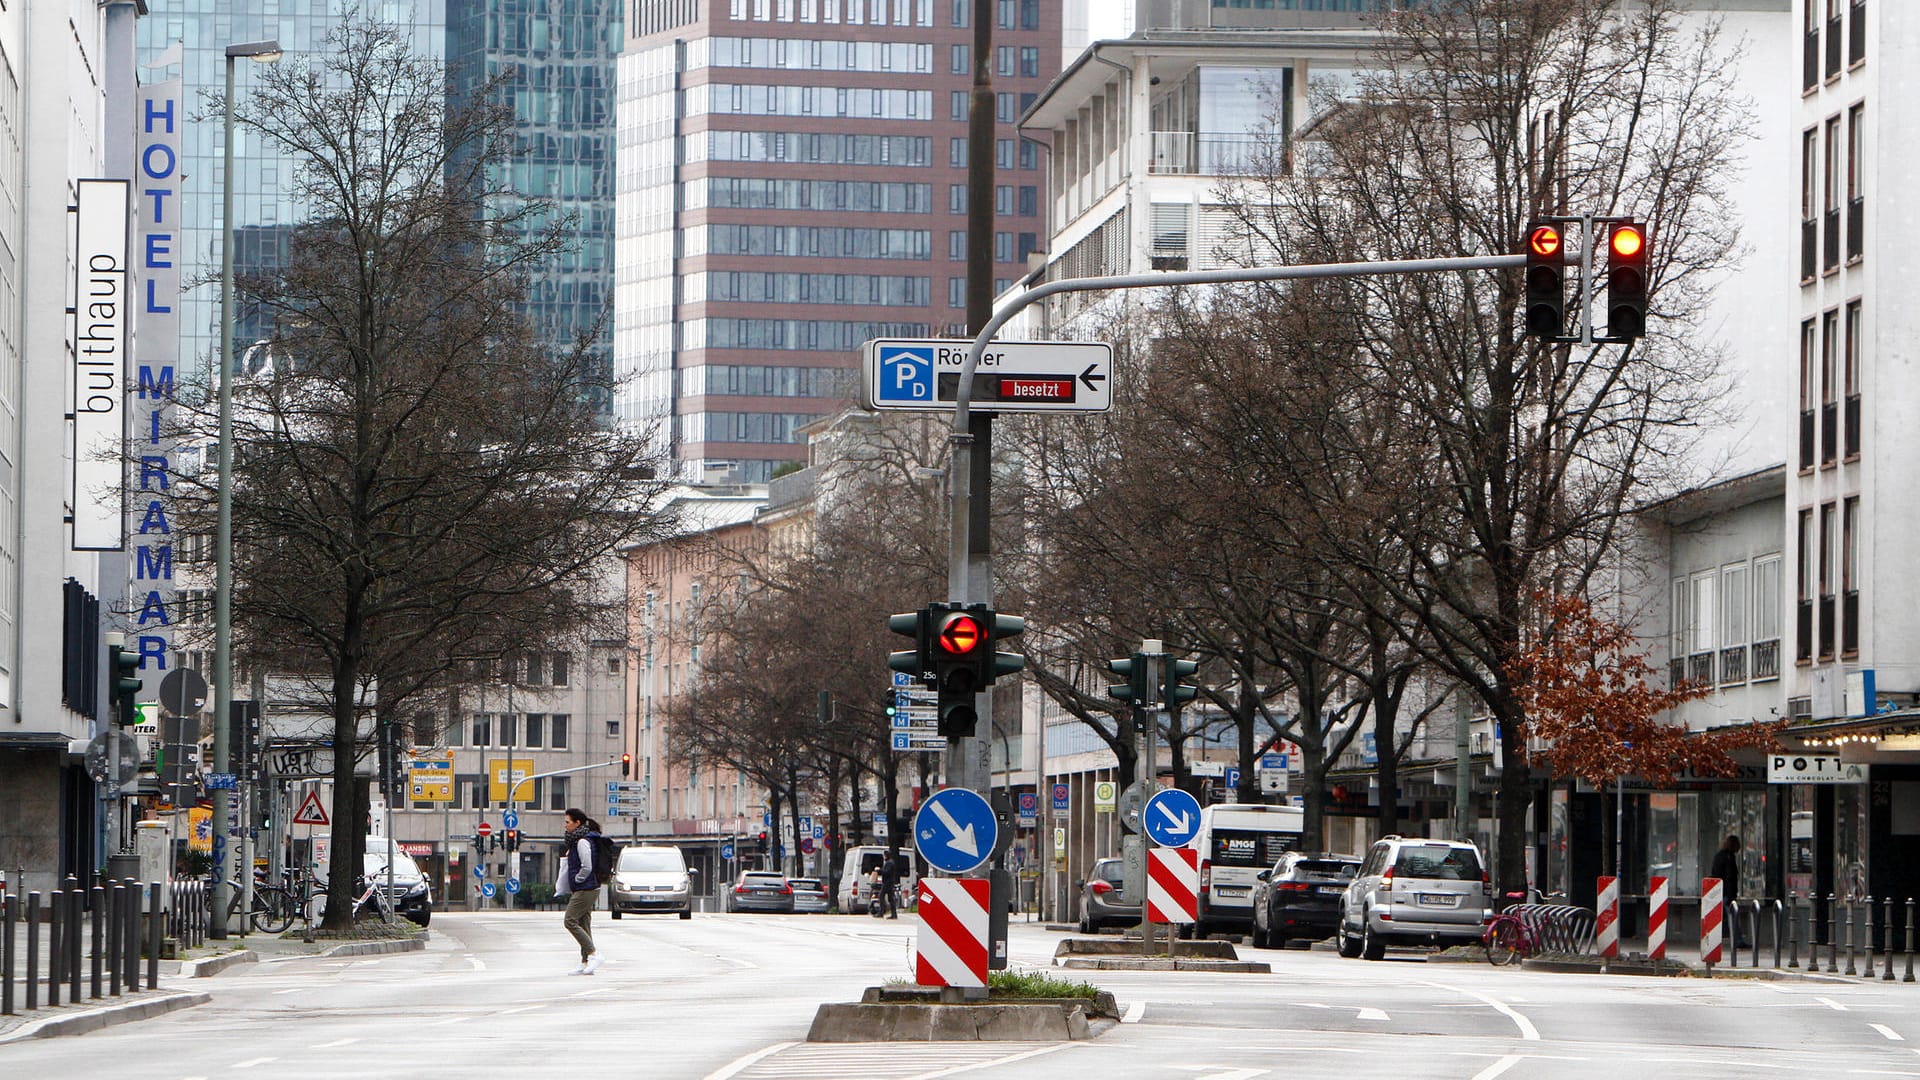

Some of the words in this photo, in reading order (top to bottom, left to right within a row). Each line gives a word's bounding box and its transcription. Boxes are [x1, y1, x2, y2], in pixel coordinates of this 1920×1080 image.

[142, 99, 176, 314] HOTEL
[77, 254, 125, 413] bulthaup
[1013, 381, 1059, 397] besetzt
[136, 365, 174, 671] MIRAMAR
[1773, 757, 1842, 771] POTT
